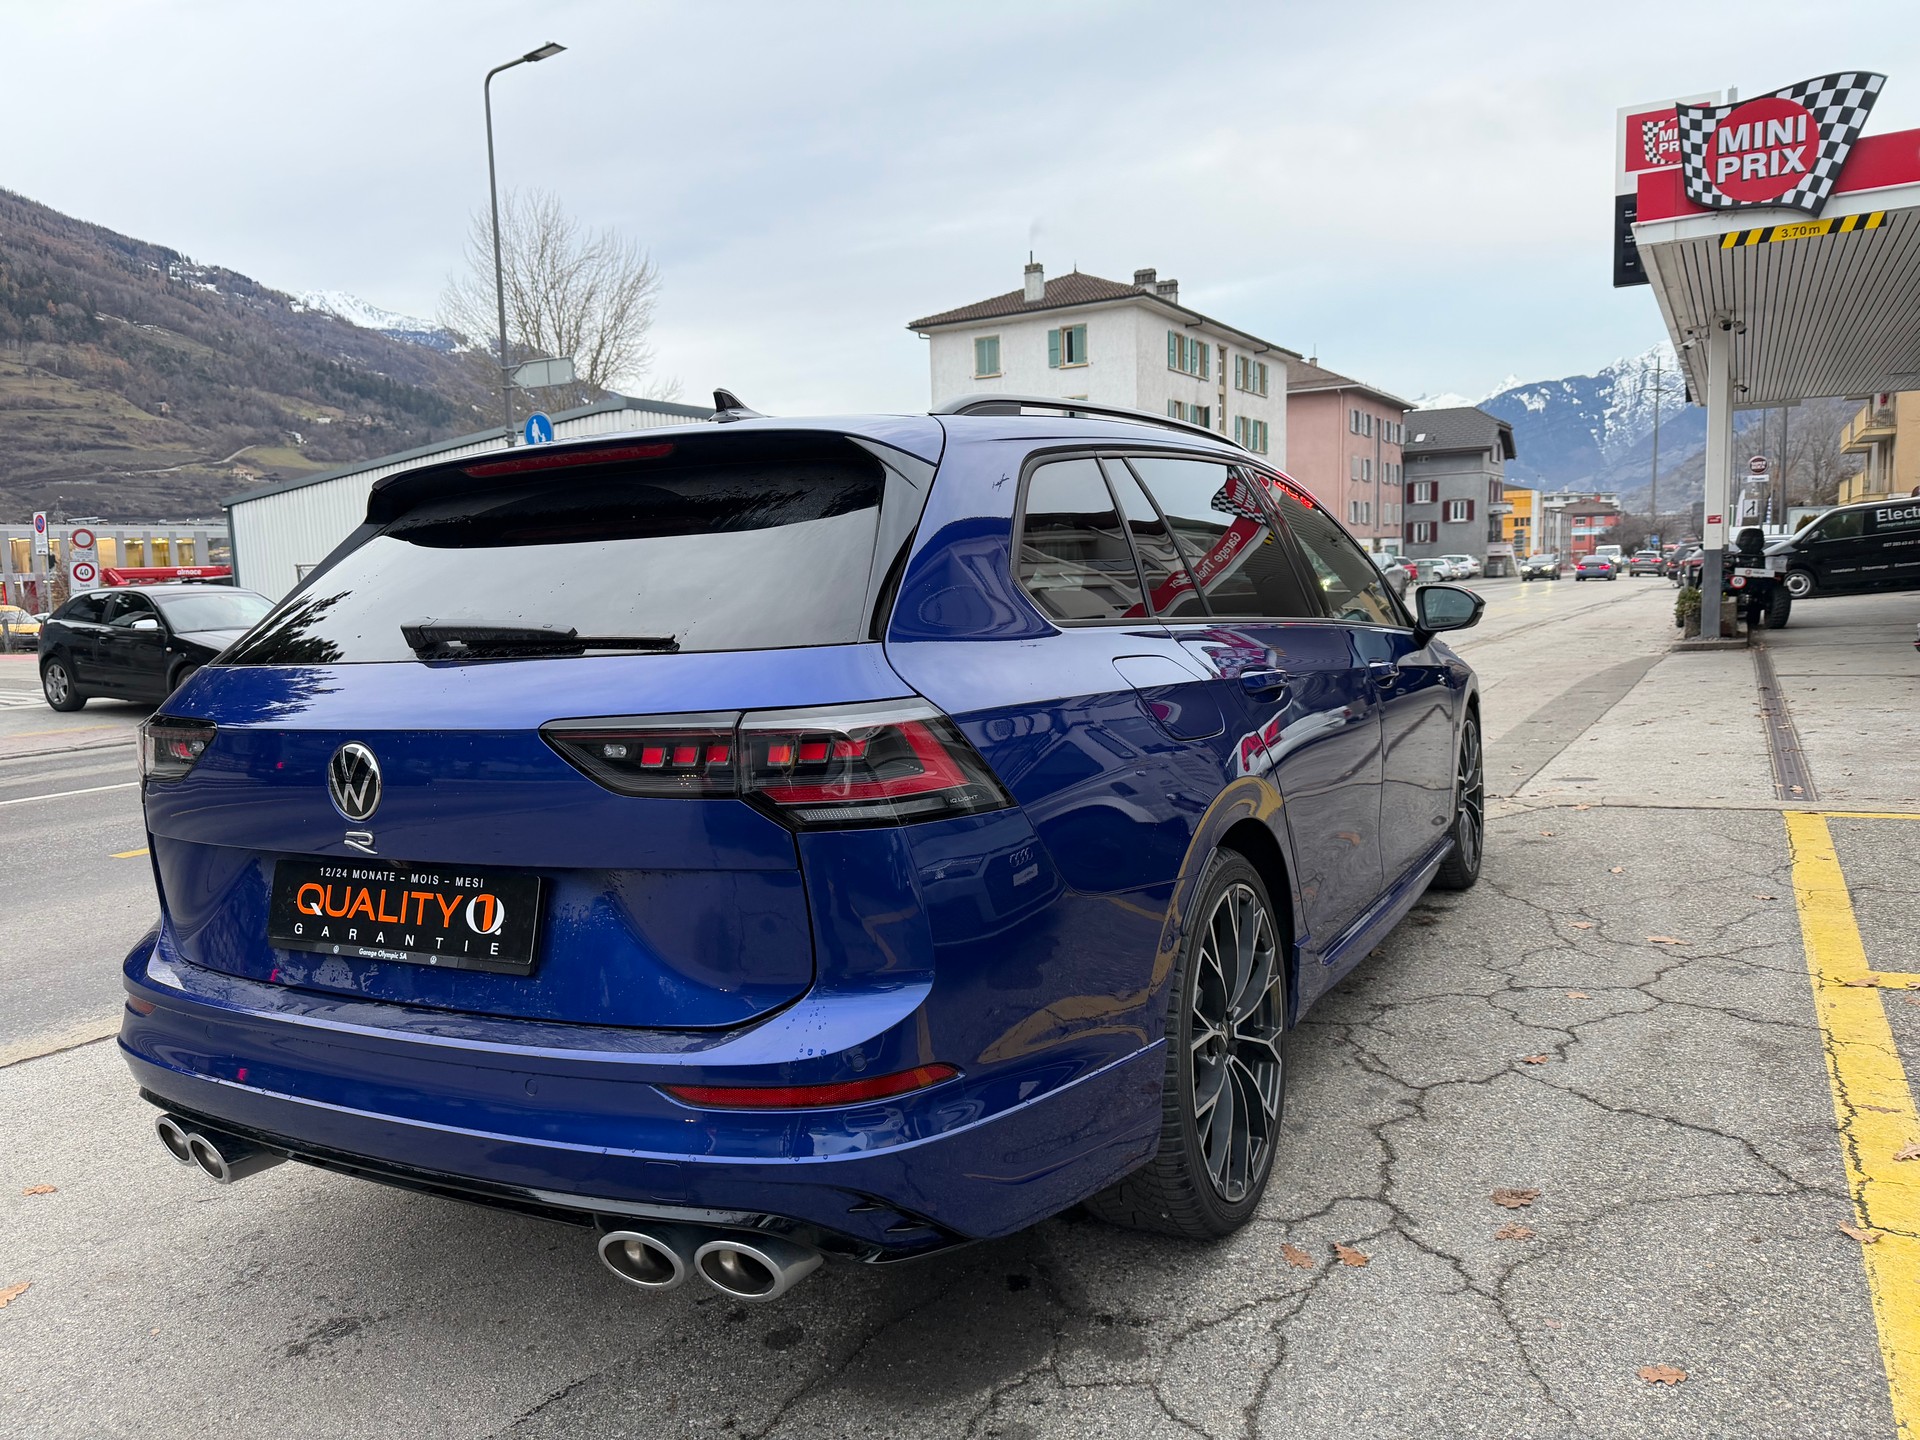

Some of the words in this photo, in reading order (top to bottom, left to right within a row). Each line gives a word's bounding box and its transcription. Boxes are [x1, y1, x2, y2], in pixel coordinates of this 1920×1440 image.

[1718, 114, 1807, 154] MINI
[1716, 145, 1807, 184] PRIX
[79, 568, 89, 576] 40
[319, 867, 348, 878] 12/24
[352, 869, 396, 882] MONATE
[410, 873, 440, 885] MOIS
[455, 876, 484, 888] MESI
[296, 882, 464, 928] QUALITY
[294, 922, 500, 956] GARANTIE
[358, 947, 378, 958] Garage
[378, 949, 399, 960] Olympic
[399, 952, 408, 960] SA
